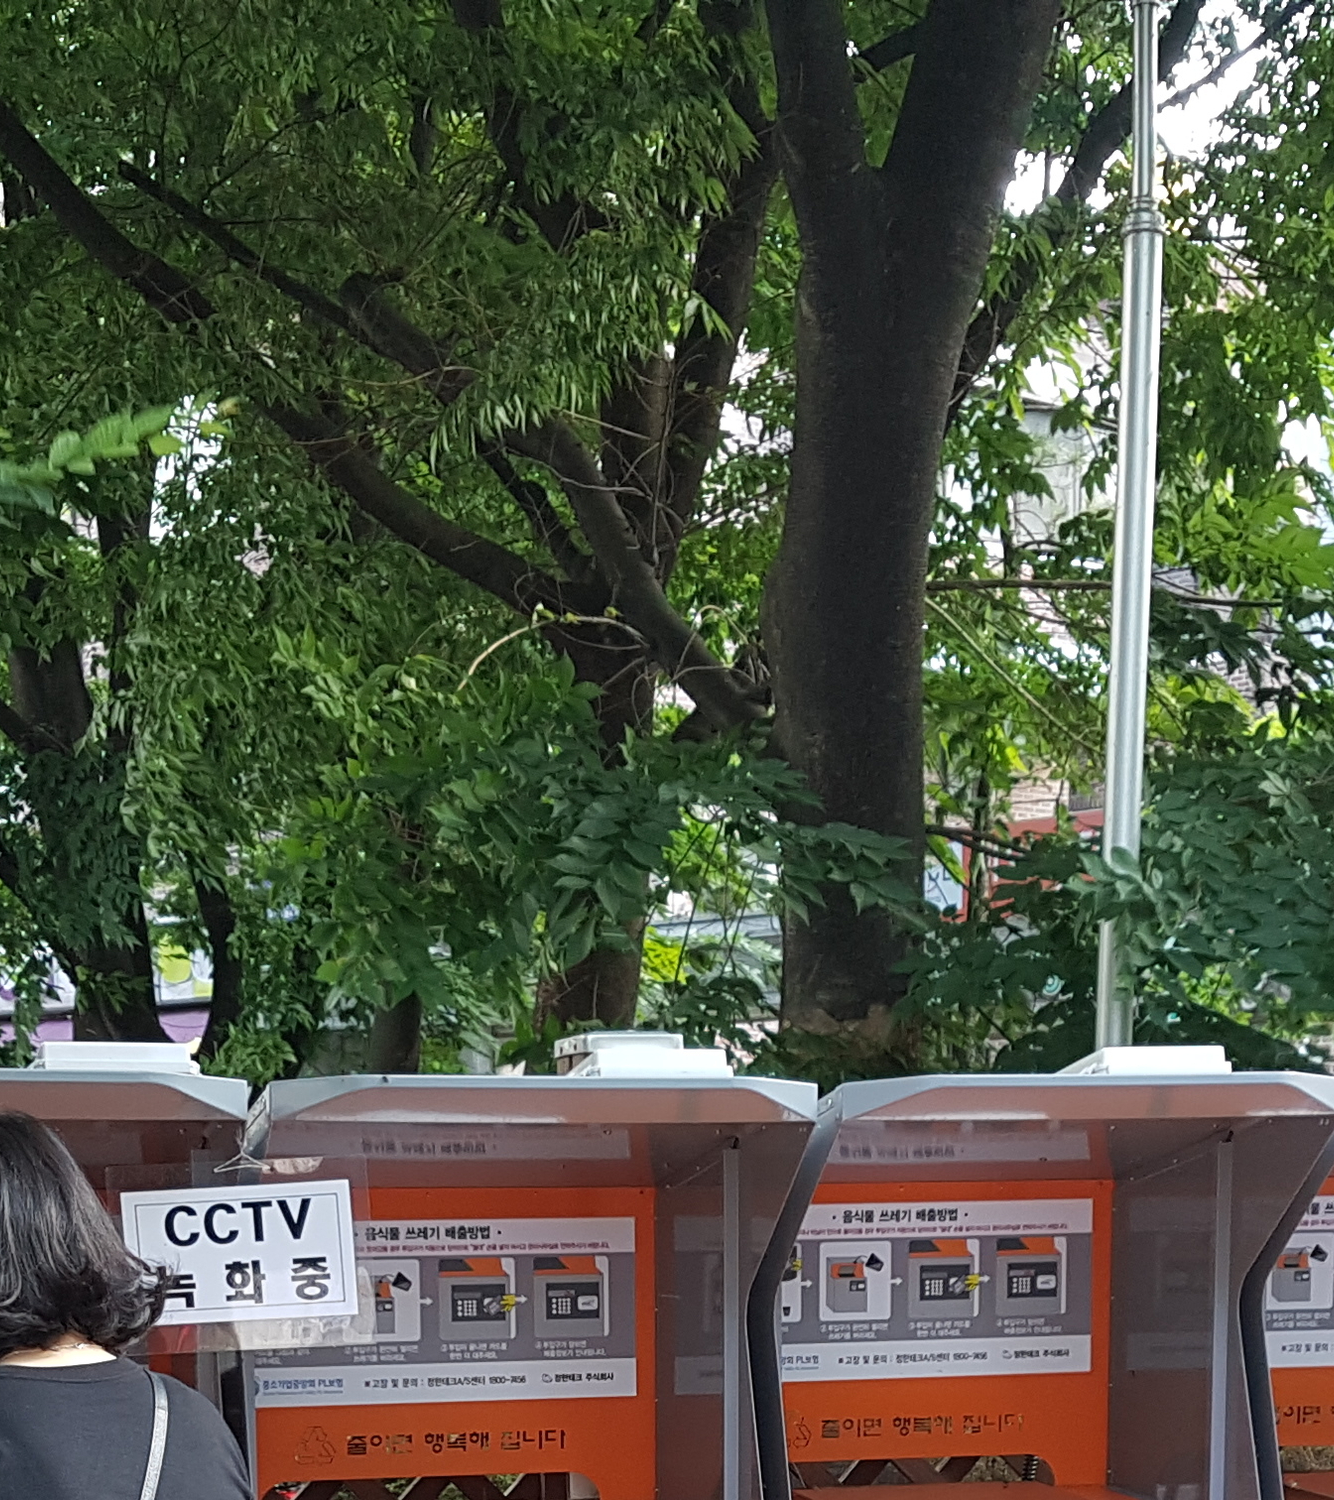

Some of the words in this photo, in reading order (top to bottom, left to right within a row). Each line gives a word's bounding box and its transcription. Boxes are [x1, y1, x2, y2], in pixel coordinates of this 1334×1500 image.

[164, 1197, 313, 1247] CCTV
[842, 1209, 874, 1224] 음식물
[879, 1209, 912, 1223] 쓰레기
[915, 1208, 958, 1222] 배출방법
[365, 1226, 400, 1241] 음식물
[405, 1226, 440, 1241] 쓰레기
[445, 1225, 490, 1240] 배출방법
[821, 1417, 882, 1439] 줄이면
[893, 1415, 953, 1437] 행복해
[962, 1413, 1025, 1435] 집니다
[346, 1433, 413, 1456] 줄이면
[424, 1430, 490, 1454] 행복해
[500, 1429, 566, 1451] 집니다
